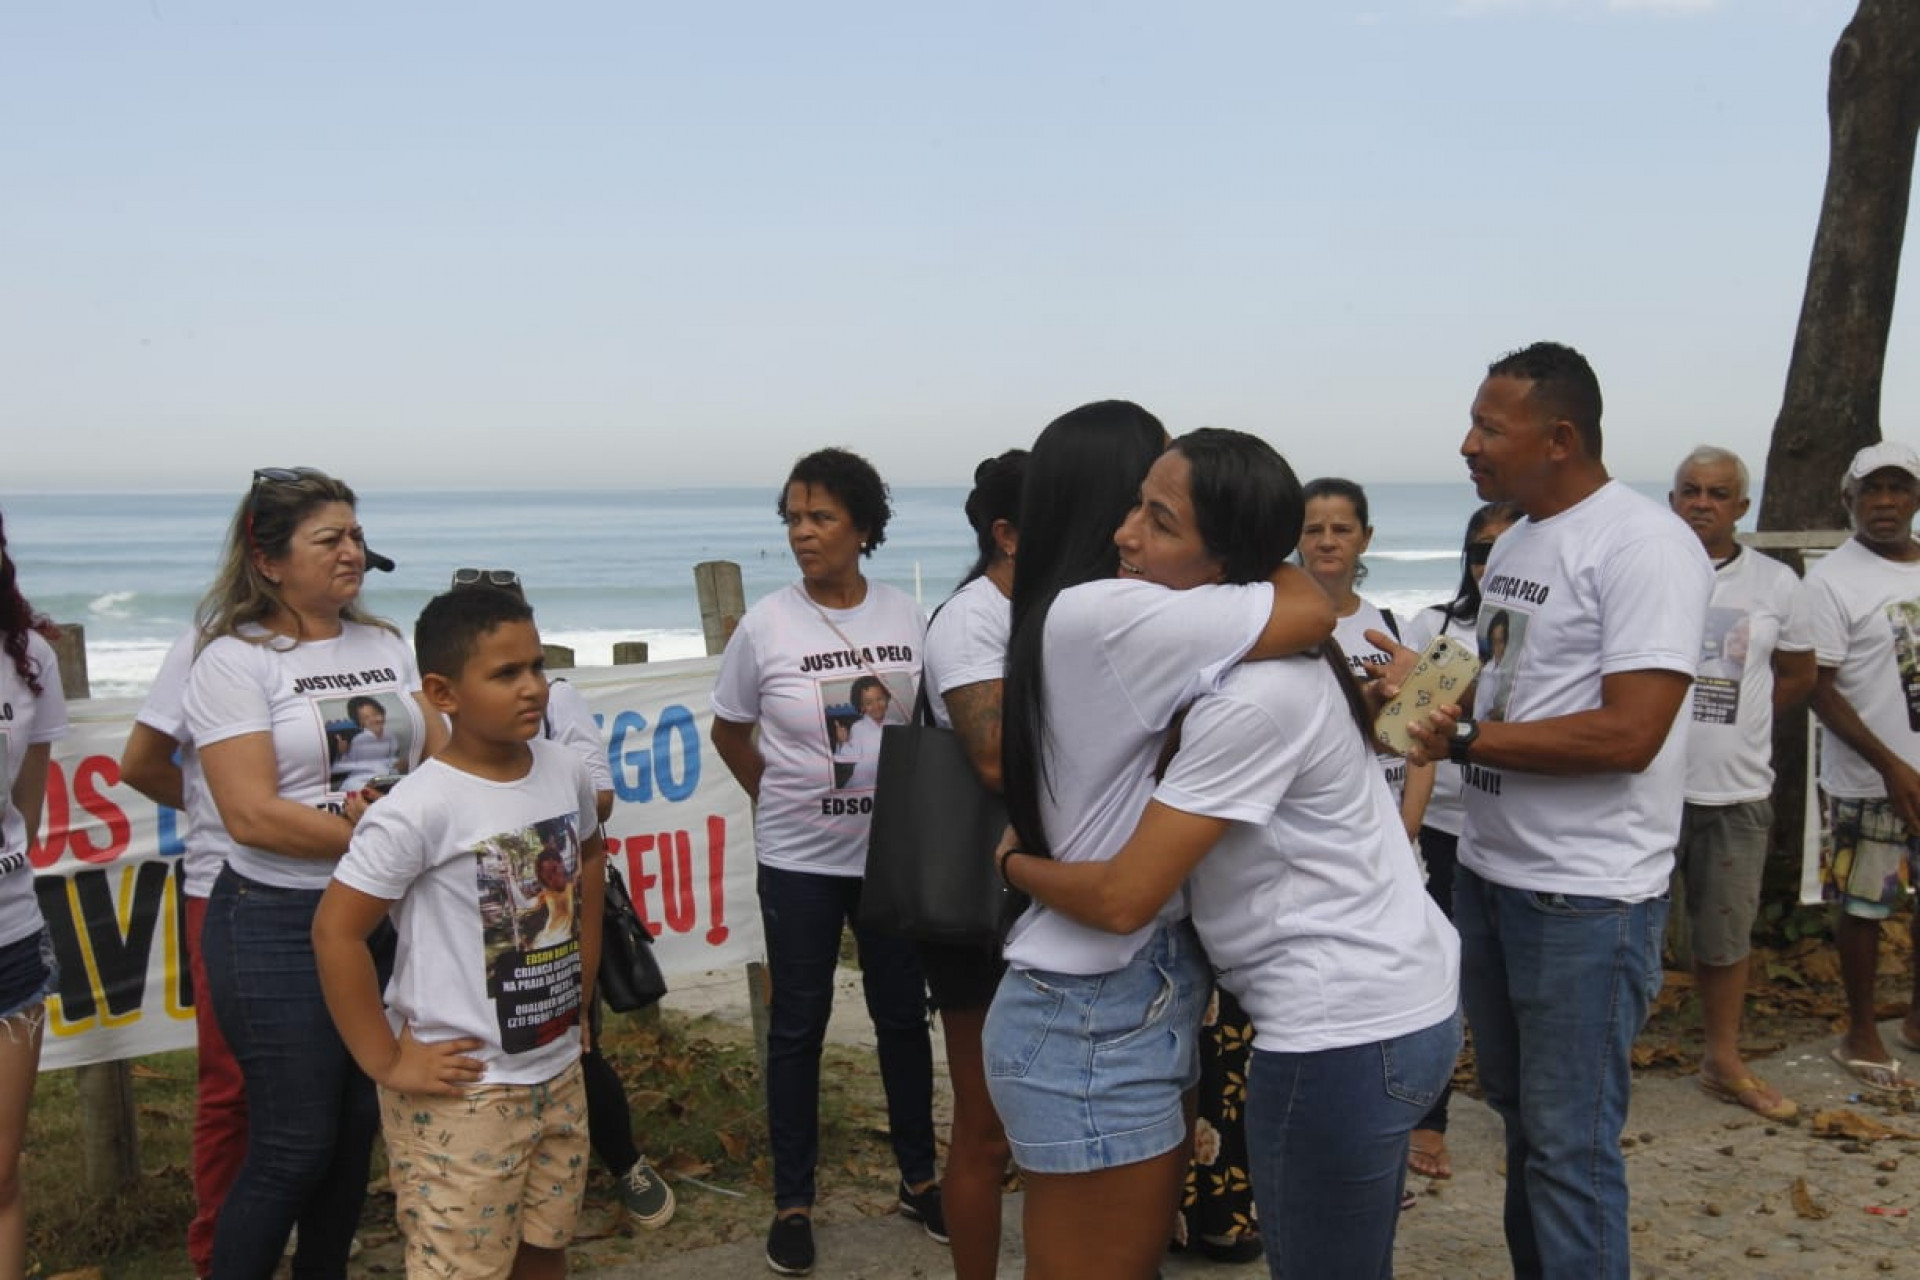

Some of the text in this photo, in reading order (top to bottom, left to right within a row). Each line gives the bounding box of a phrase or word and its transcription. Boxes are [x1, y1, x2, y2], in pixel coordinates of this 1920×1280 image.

[1518, 580, 1550, 604] PELO
[801, 645, 912, 672] JUSTIÇA PELO
[293, 667, 397, 694] JUSTIÇA PELO
[593, 704, 701, 803] GO
[604, 815, 729, 946] EU!
